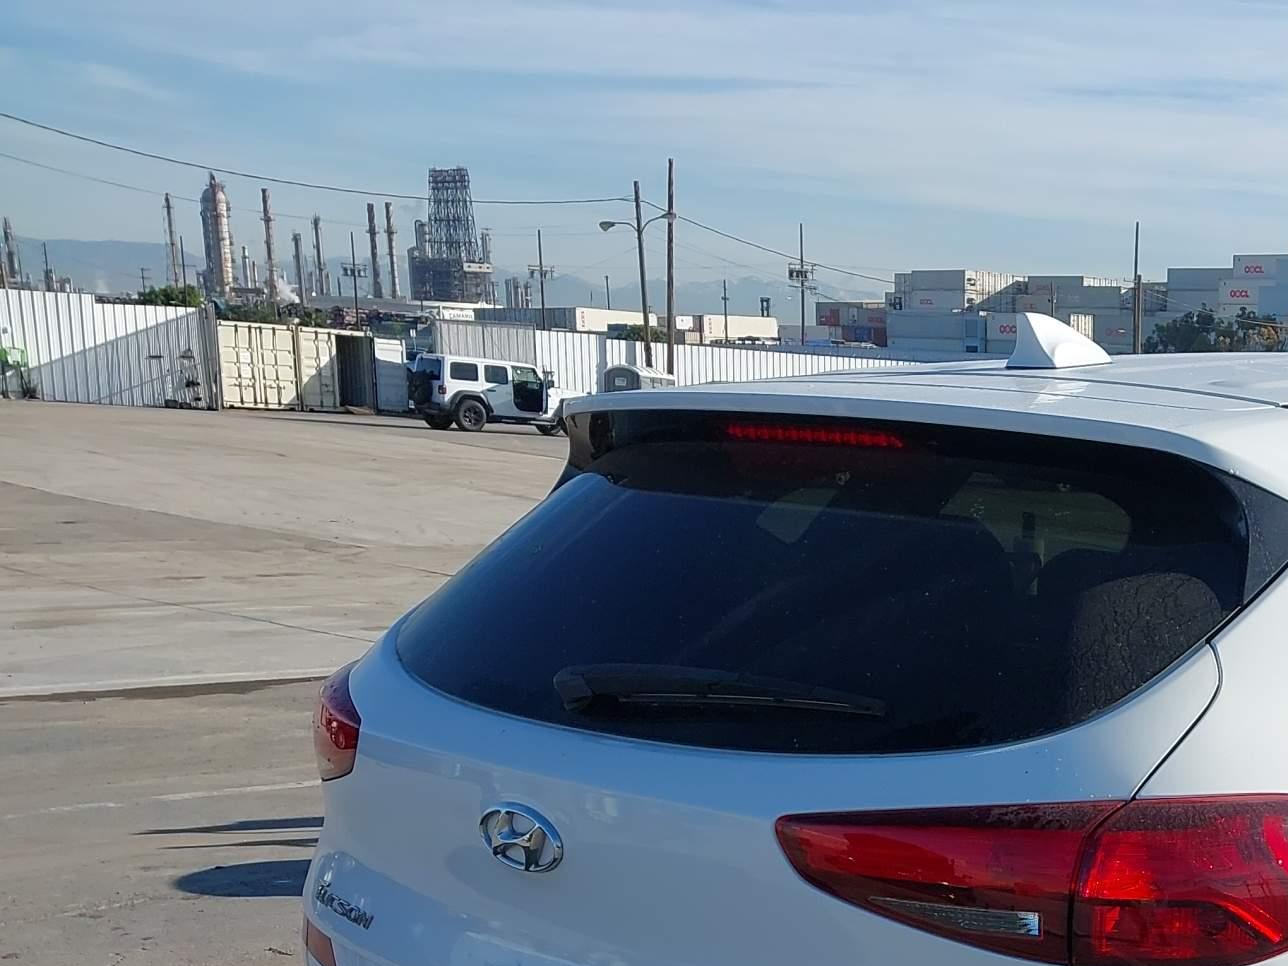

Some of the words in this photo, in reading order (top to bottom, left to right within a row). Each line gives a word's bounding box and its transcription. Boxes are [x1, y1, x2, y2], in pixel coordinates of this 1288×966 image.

[1244, 265, 1265, 274] OOCL
[1230, 289, 1249, 298] OOCL
[999, 324, 1018, 334] OOC
